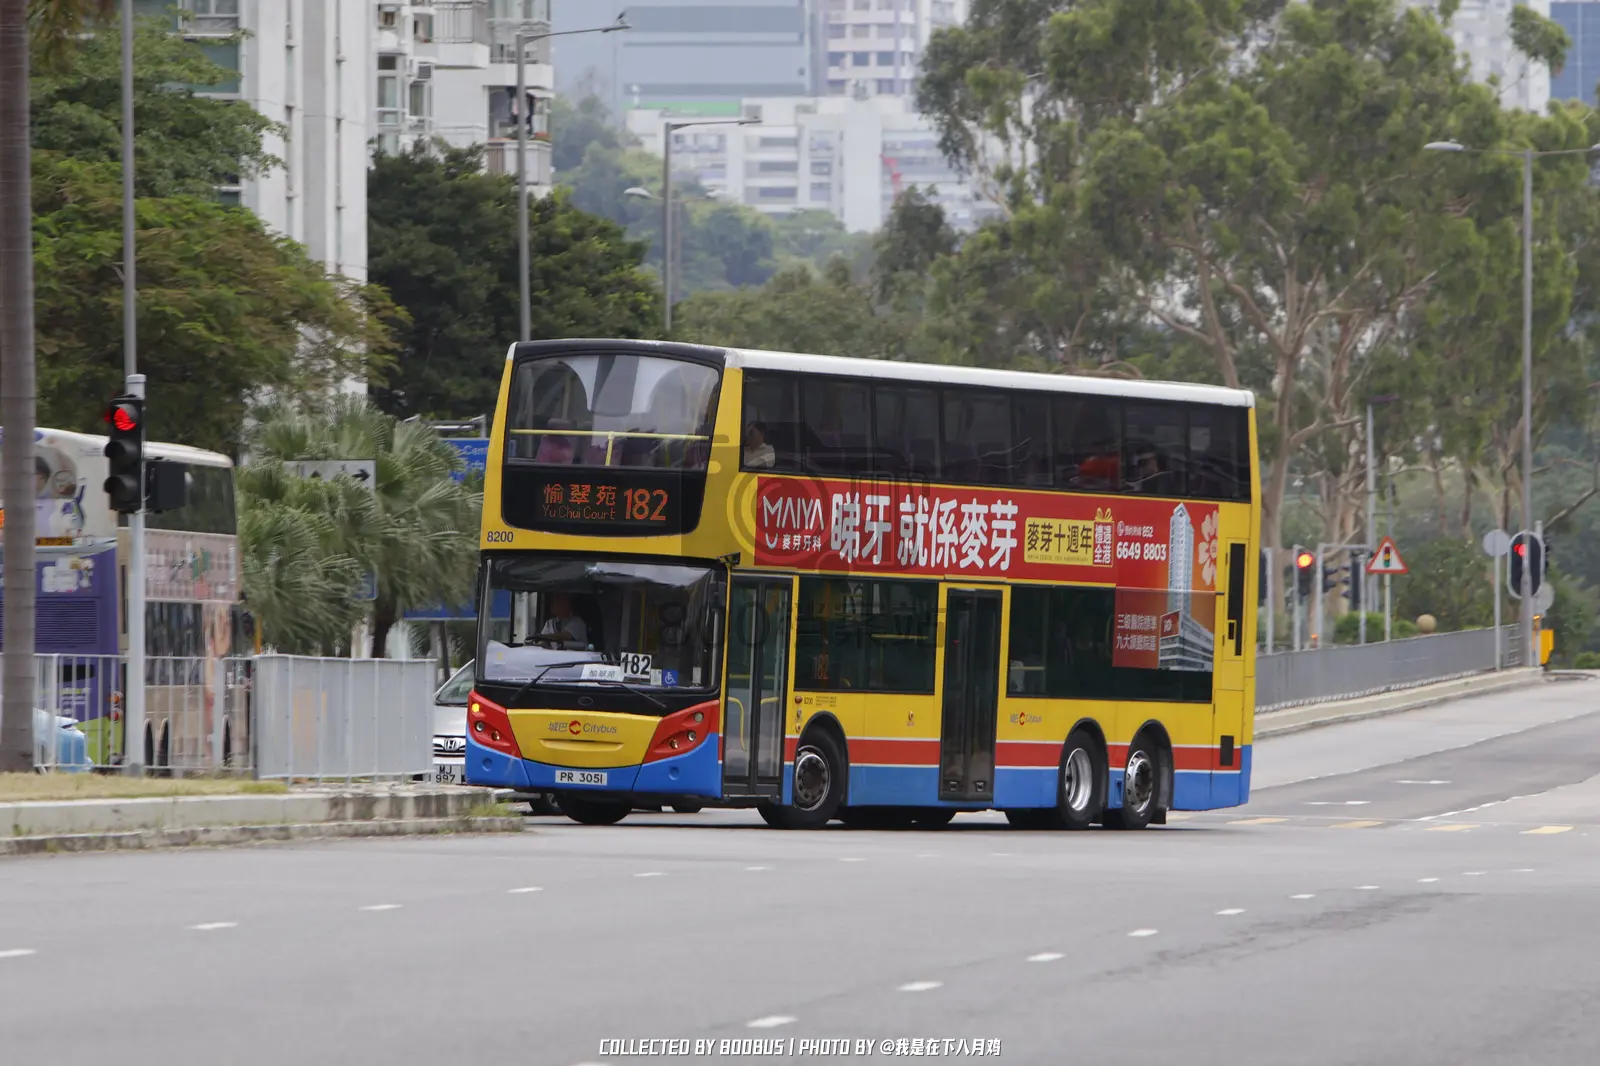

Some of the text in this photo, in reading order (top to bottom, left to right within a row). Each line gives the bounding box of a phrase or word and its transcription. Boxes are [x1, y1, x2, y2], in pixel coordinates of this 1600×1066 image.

[543, 483, 617, 506] 愉翠苑
[623, 488, 669, 521] 182
[542, 504, 616, 519] Yu Chui Court
[762, 495, 825, 531] MAIYA
[486, 530, 514, 543] 8200
[1027, 521, 1093, 555] 麥芽十週年
[1116, 541, 1167, 561] 6649 8803
[621, 653, 650, 675] 182
[582, 723, 617, 734] Citybus
[435, 773, 456, 784] 997
[560, 771, 603, 784] PR 3051
